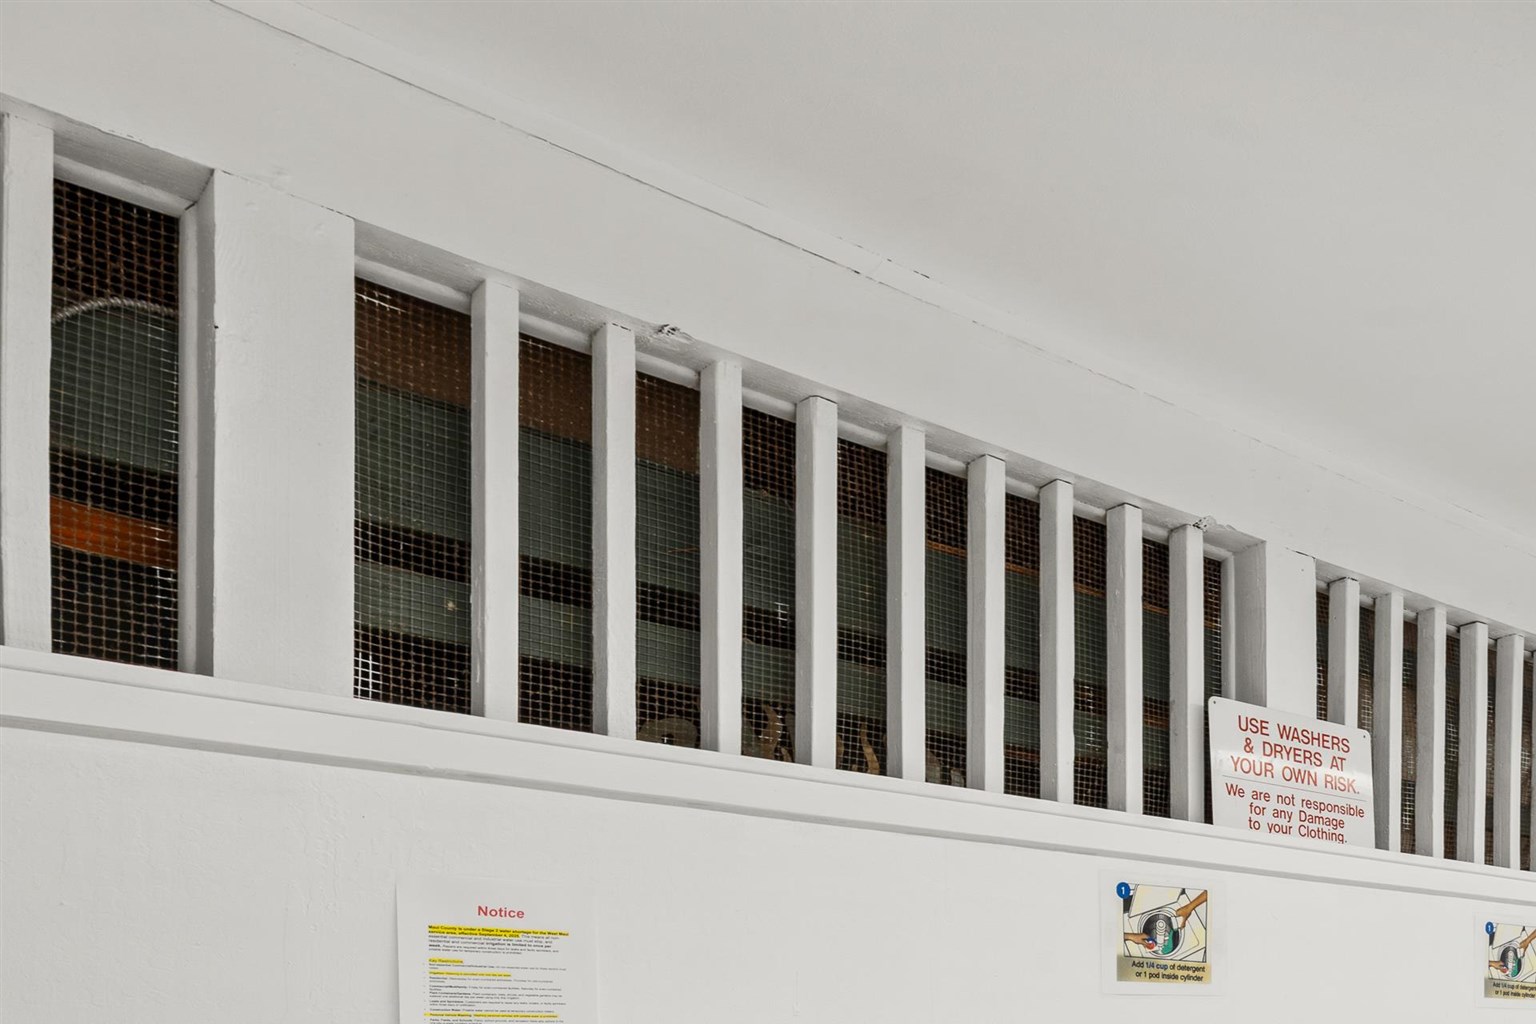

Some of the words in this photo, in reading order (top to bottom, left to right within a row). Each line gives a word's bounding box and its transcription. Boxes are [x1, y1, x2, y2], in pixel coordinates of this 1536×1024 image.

[1238, 715, 1269, 736] USE
[1277, 723, 1350, 753] WASHERS
[1244, 738, 1254, 753] &
[1263, 742, 1322, 767] DRYERS
[1330, 756, 1346, 772] AT
[1231, 756, 1274, 778] YOUR
[1282, 766, 1317, 786] OWN
[1324, 774, 1360, 794] RISK.
[1226, 783, 1244, 797] We
[1252, 790, 1270, 802] are
[1277, 793, 1295, 806] not
[1302, 798, 1364, 818] responsible
[1249, 803, 1266, 816] for
[1272, 808, 1292, 822] any
[1299, 810, 1345, 830] Damage
[1249, 818, 1260, 830] to
[1267, 822, 1292, 835] your
[1299, 825, 1347, 844] Clothing.
[478, 905, 524, 918] Notice
[1177, 964, 1205, 973] detergent
